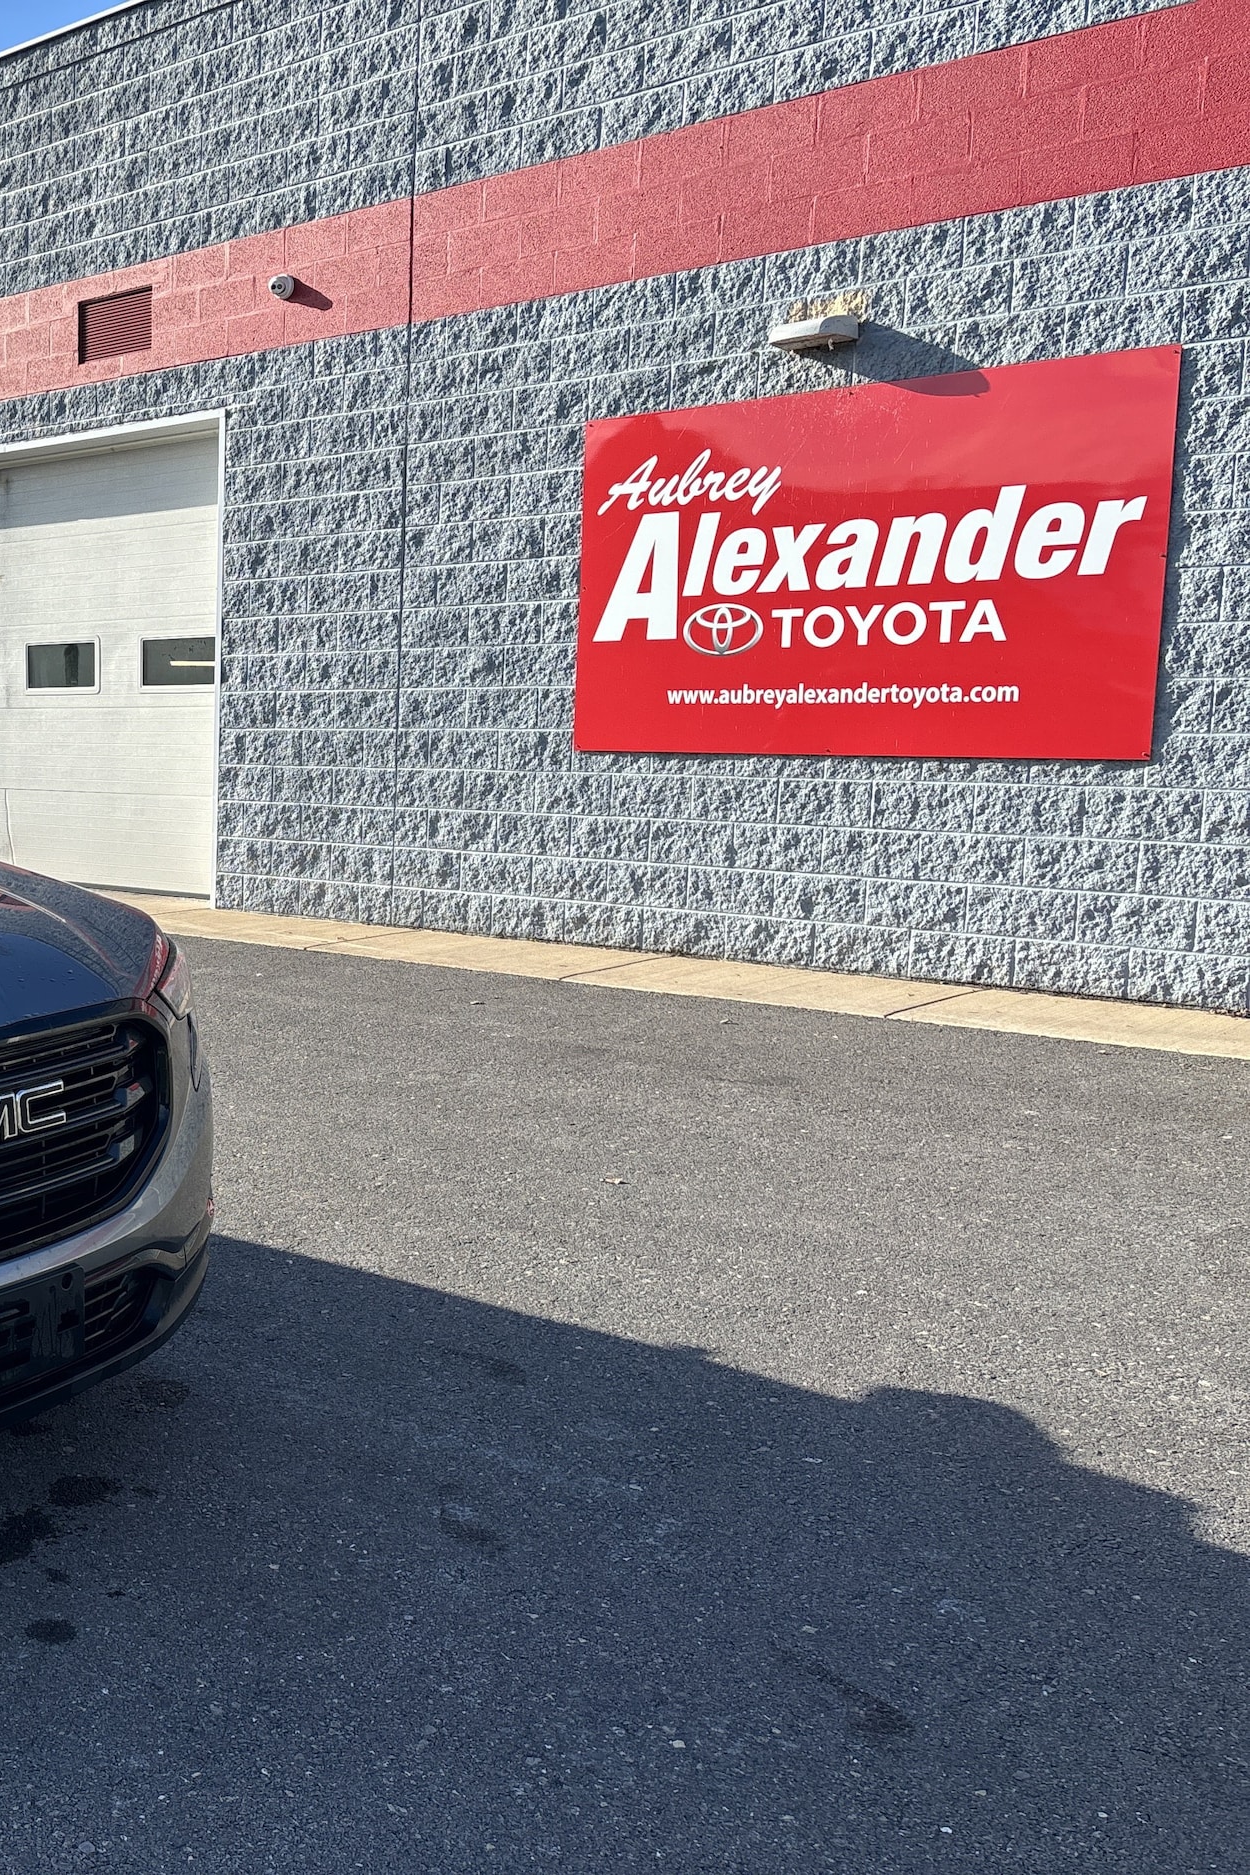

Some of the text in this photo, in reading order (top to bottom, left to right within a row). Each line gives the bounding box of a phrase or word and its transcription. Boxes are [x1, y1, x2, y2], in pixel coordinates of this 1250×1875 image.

[597, 448, 782, 516] Aubrey
[592, 484, 1148, 642] Alexander
[771, 600, 1007, 648] TOYOTA
[667, 683, 1020, 710] www.aubreyalexandertoyota.com
